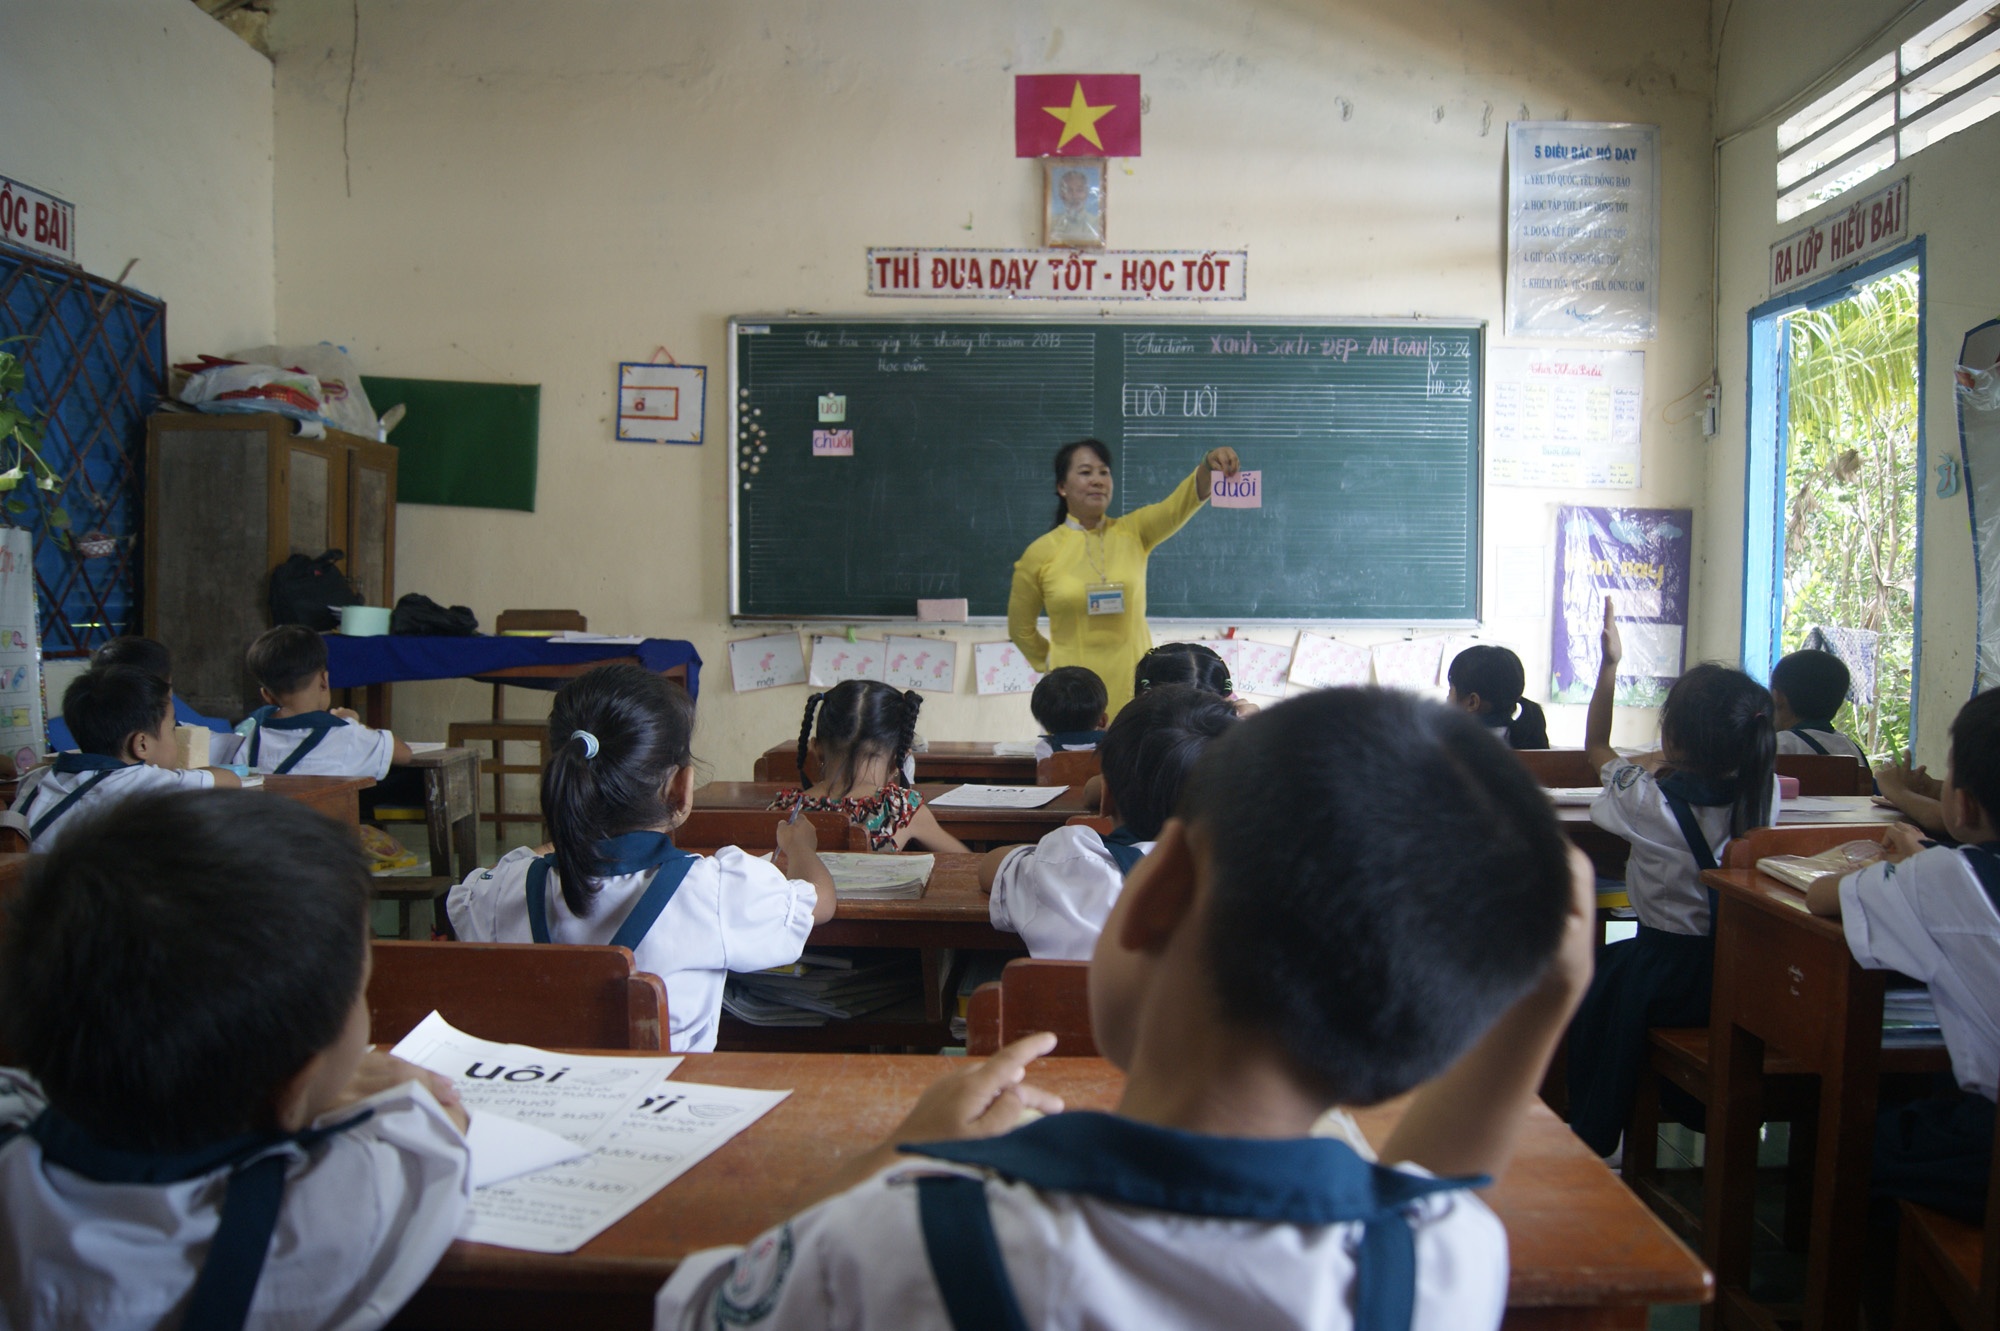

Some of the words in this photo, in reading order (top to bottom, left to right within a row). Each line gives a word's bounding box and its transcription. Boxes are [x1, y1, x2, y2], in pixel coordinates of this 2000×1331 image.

[1534, 145, 1541, 158] 5
[1615, 147, 1637, 164] DẠY
[34, 201, 68, 252] BÀI
[1775, 246, 1793, 286] RA
[1796, 225, 1824, 277] LỚP
[1831, 201, 1867, 262] HIỂU
[1870, 185, 1902, 243] BÀI
[931, 258, 984, 290] ĐUA
[989, 258, 1039, 297] DẠY
[1048, 250, 1097, 291] TỐT
[1121, 259, 1175, 298] HỌC
[1182, 251, 1231, 292] TỐT
[909, 677, 923, 688] ba
[465, 1062, 571, 1082] uôi
